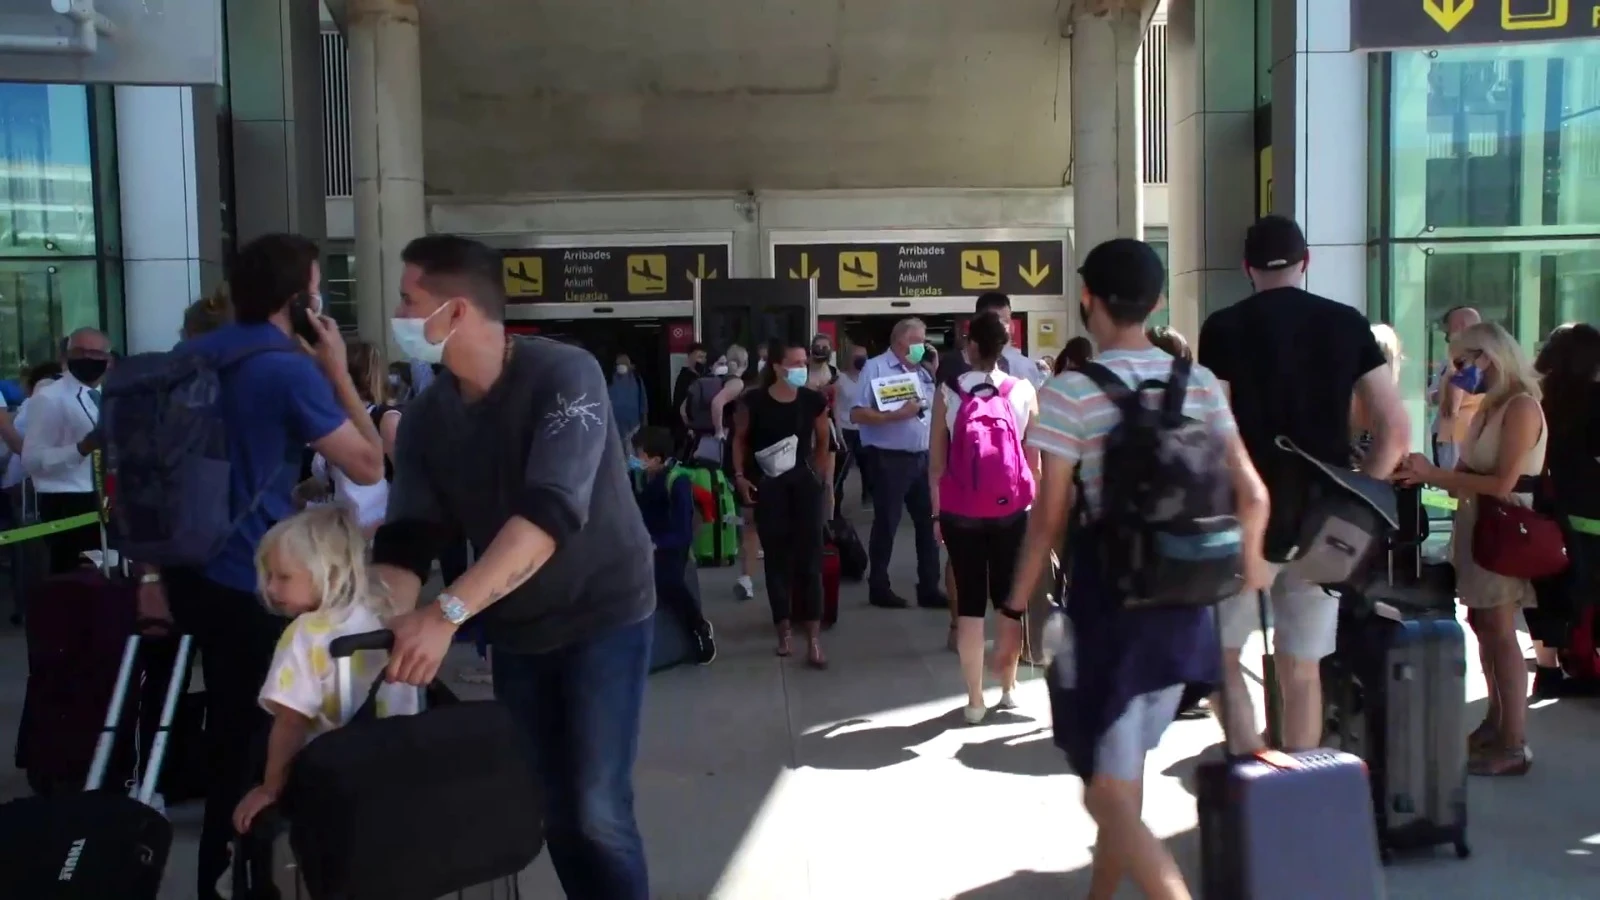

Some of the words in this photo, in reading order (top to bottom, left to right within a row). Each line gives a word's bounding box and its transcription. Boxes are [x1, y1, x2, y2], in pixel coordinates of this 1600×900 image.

[563, 249, 611, 260] Arribades
[898, 245, 946, 256] Arribades
[564, 263, 594, 274] Arrivals
[898, 258, 928, 270] Arrivals
[564, 277, 594, 288] Ankunft
[898, 272, 928, 283] Ankunft
[899, 285, 943, 297] Llegadas
[58, 838, 87, 881] THULE
